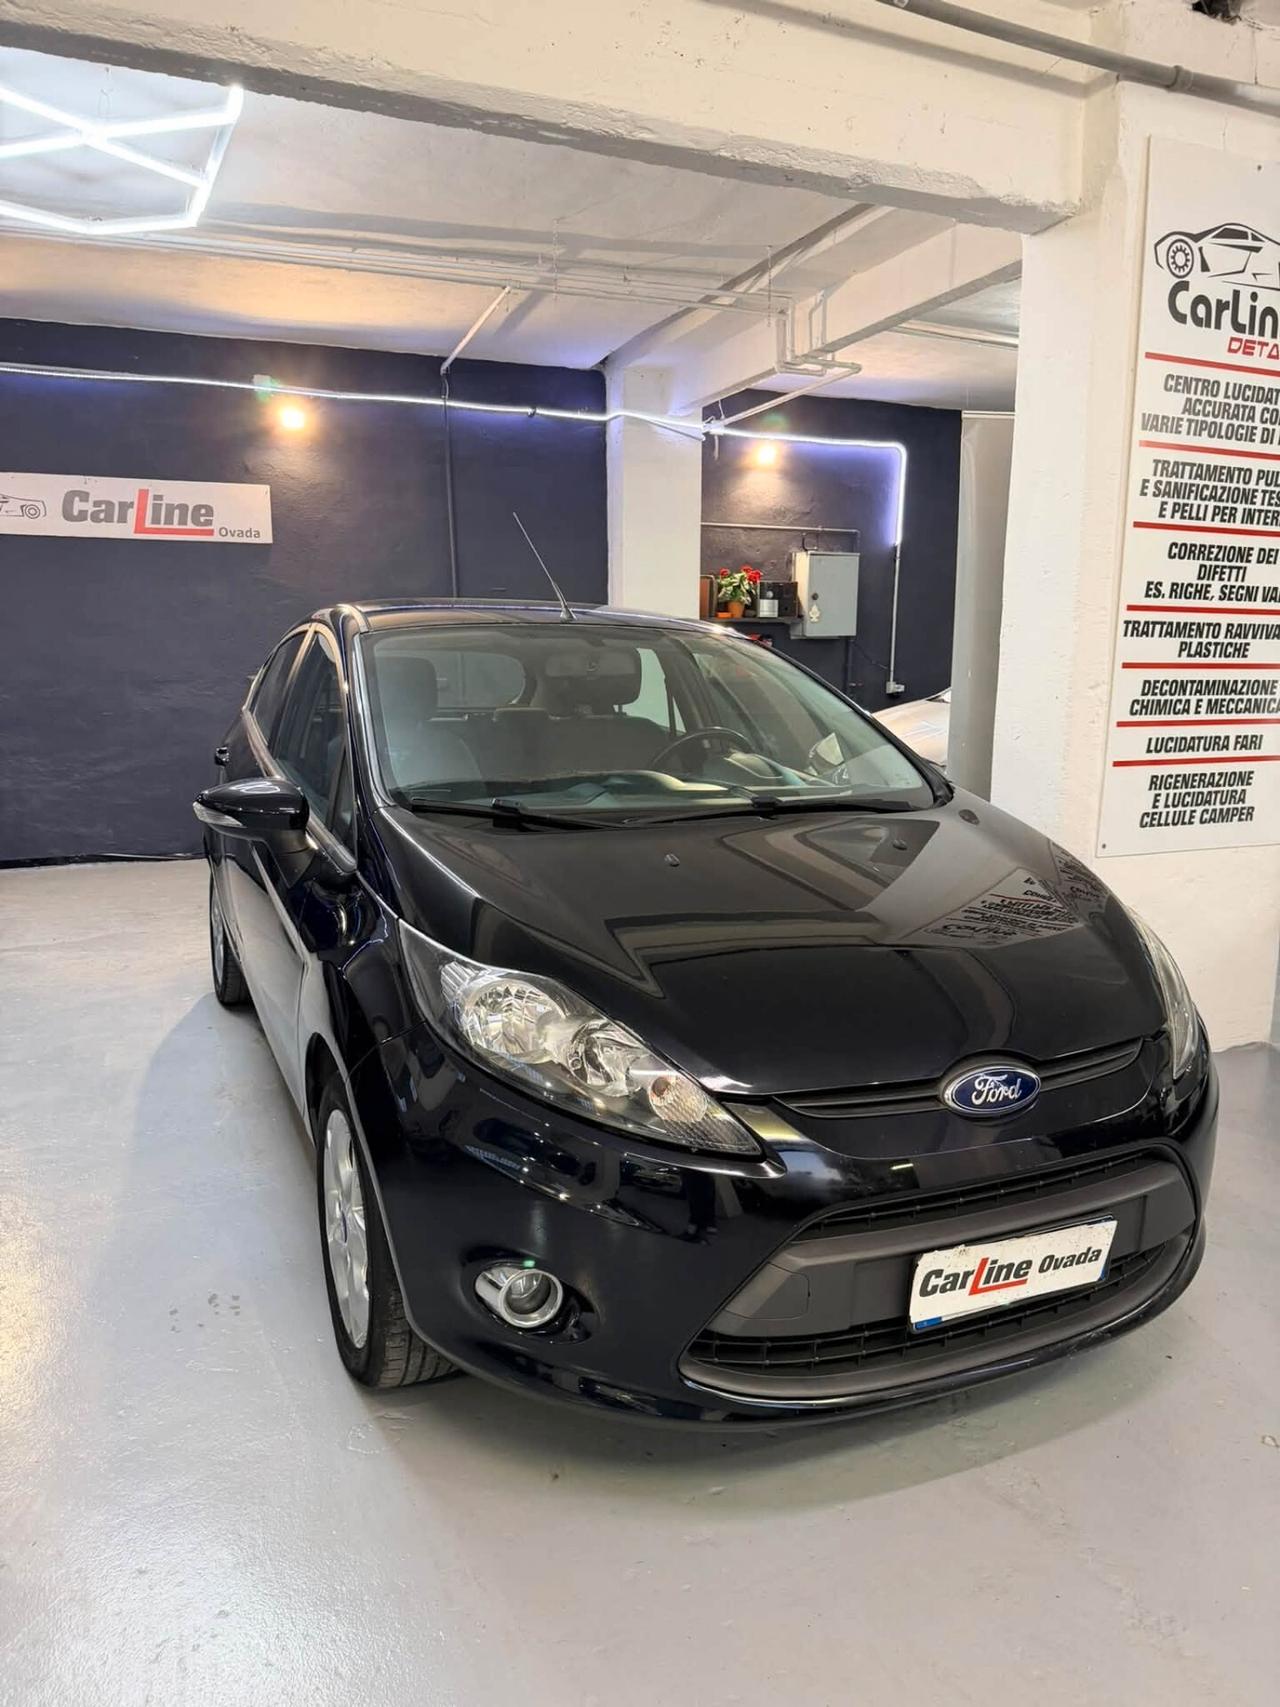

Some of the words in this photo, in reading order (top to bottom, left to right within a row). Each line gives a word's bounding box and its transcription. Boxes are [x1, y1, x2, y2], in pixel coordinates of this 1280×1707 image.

[1163, 373, 1221, 398] CENTRO
[1181, 397, 1256, 423] ACCURATA
[1259, 406, 1280, 426] CO
[1141, 412, 1184, 435] VARIE
[1186, 417, 1258, 443] TIPOLOGIE
[1260, 426, 1276, 445] DI
[1152, 459, 1253, 486] TRATTAMENTO
[1139, 479, 1150, 497] E
[1152, 480, 1258, 506] SANIFICAZIONE
[61, 488, 215, 536] CarLine
[218, 526, 261, 539] Ovada
[1158, 501, 1168, 518] E
[1170, 502, 1208, 522] PELLI
[1211, 505, 1238, 524] PER
[1167, 541, 1254, 563] CORREZIONE
[1256, 548, 1279, 565] DEI
[1197, 564, 1248, 583] DIFETTI
[1144, 581, 1165, 599] ES.
[1168, 582, 1215, 601] RIGHE,
[1218, 584, 1260, 602] SEGNI
[1261, 586, 1280, 603] VA
[1123, 620, 1222, 639] TRATTAMENTO
[1177, 641, 1251, 659] PLASTICHE
[1140, 679, 1279, 697] DECONTAMINAZIONE
[1129, 699, 1191, 716] CHIMICA
[1194, 699, 1204, 715] E
[1145, 735, 1231, 754] LUCIDATURA
[1233, 734, 1264, 751] FARI
[1148, 770, 1255, 791] RIGENERAZIONE
[1151, 792, 1162, 809] E
[1163, 788, 1247, 809] LUCIDATURA
[1139, 809, 1197, 829] CELLULE
[1199, 806, 1255, 825] CAMPER
[971, 1073, 1022, 1106] Ford
[918, 1257, 1033, 1298] CarLine
[1038, 1246, 1102, 1275] Ovada
